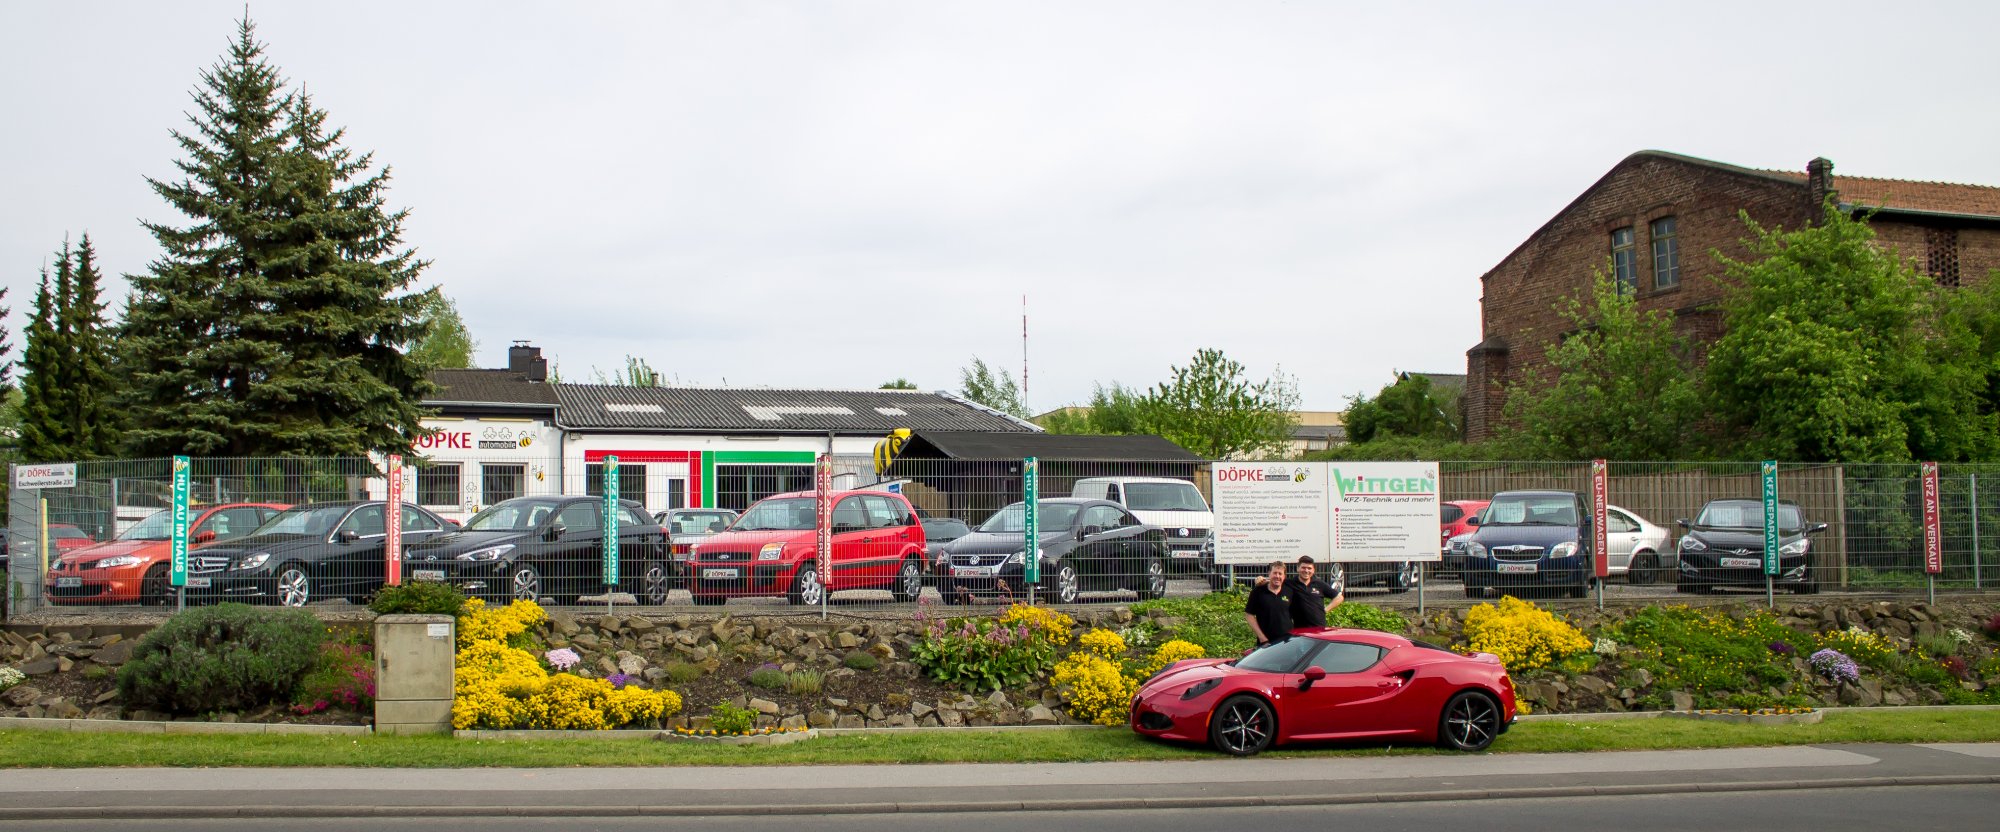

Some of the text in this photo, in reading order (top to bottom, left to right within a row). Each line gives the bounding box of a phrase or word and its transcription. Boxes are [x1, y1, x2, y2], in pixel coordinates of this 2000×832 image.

[28, 468, 51, 477] DÖPKE
[1219, 467, 1264, 481] DÖPKE
[177, 474, 186, 491] HU
[1026, 475, 1032, 491] HU
[1925, 477, 1934, 497] KFZ
[176, 505, 185, 522] AU
[818, 499, 824, 515] AN
[1026, 505, 1032, 520] AU
[1926, 499, 1934, 513] AN
[1595, 476, 1605, 555] EU-NEUWAGEN
[176, 523, 185, 538] IM
[1026, 521, 1032, 535] IM
[1765, 476, 1776, 574] KFZ REPARATUREN
[1927, 524, 1937, 570] VERKAUF
[175, 540, 185, 573] HAUS
